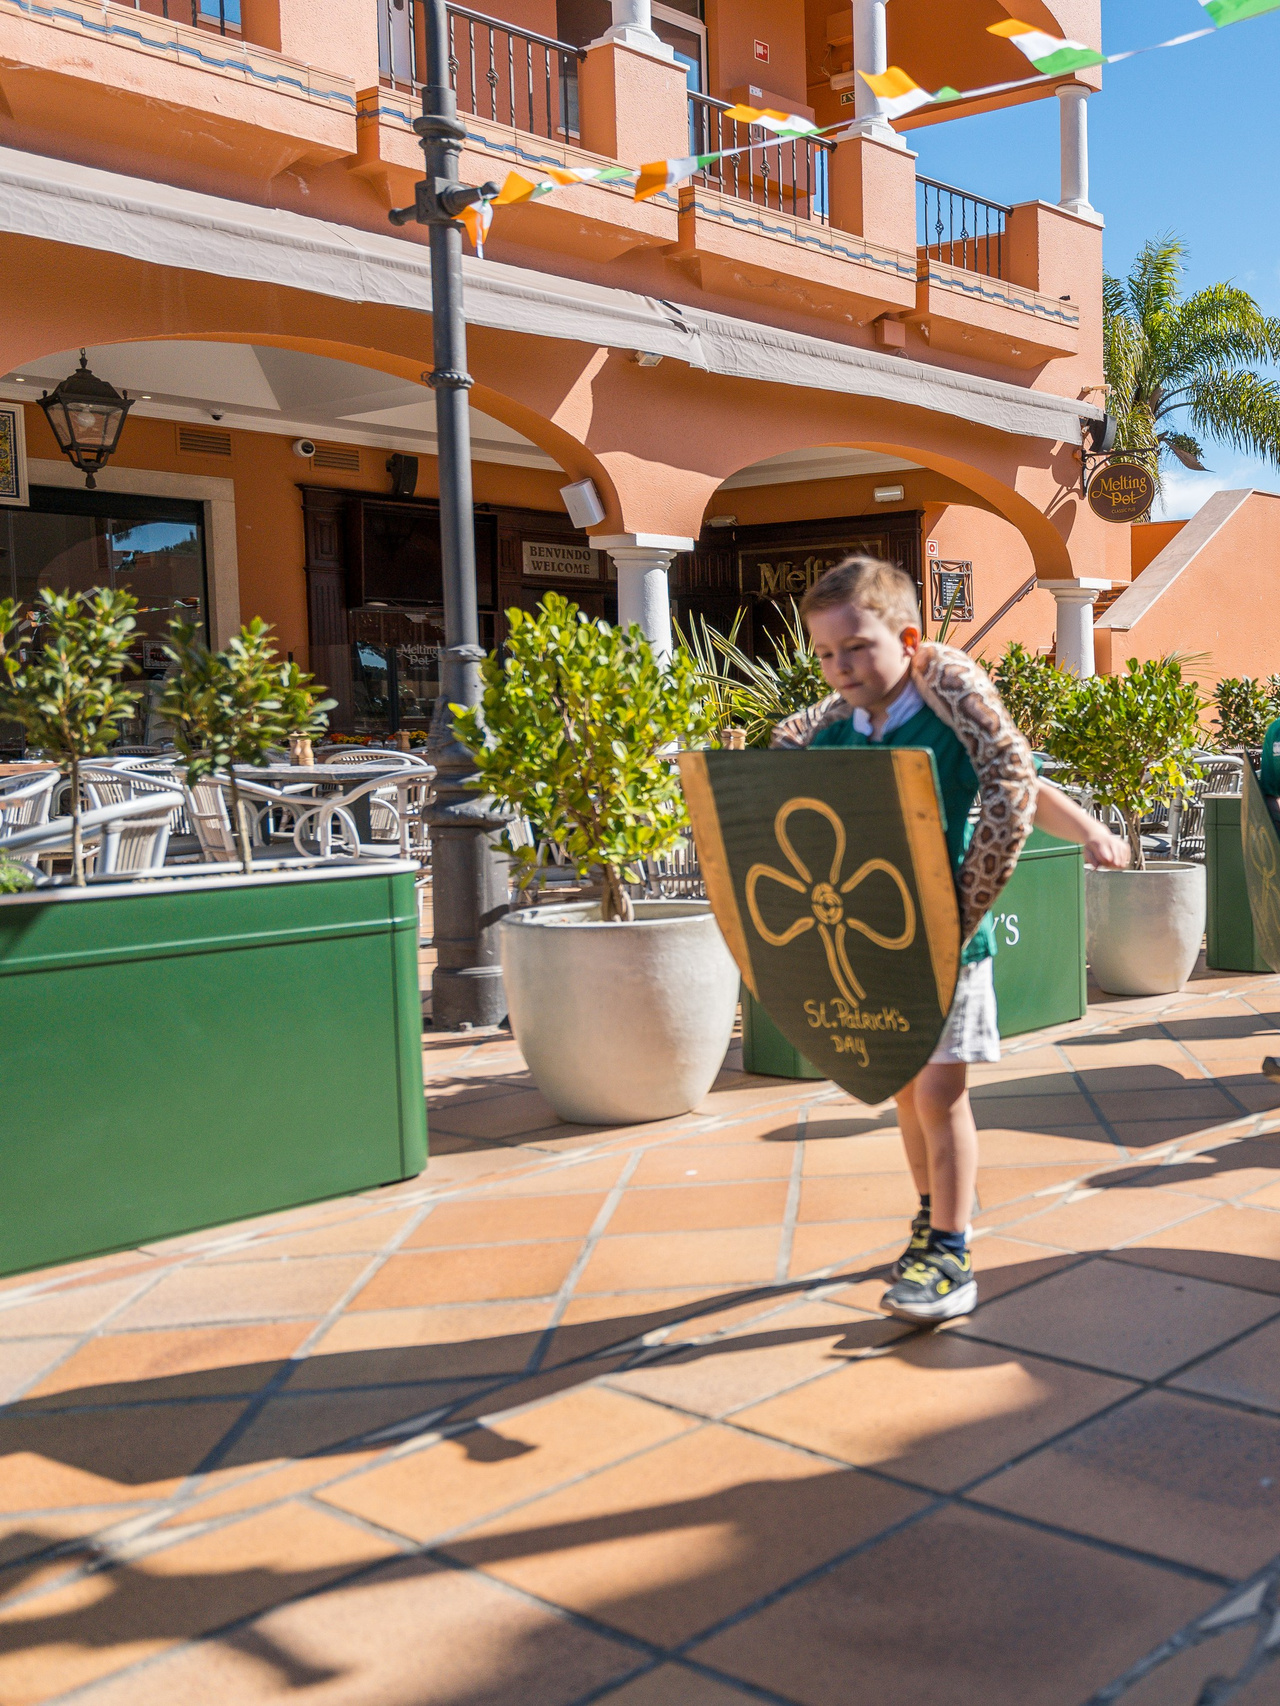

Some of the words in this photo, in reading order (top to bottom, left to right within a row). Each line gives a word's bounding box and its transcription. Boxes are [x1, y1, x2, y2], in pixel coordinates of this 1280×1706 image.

[1099, 474, 1148, 493] Melting
[1111, 490, 1137, 507] Pot
[529, 545, 591, 561] BENVINDO
[531, 560, 590, 575] WELCOME
[757, 555, 836, 597] Melt
[400, 643, 438, 659] Melting
